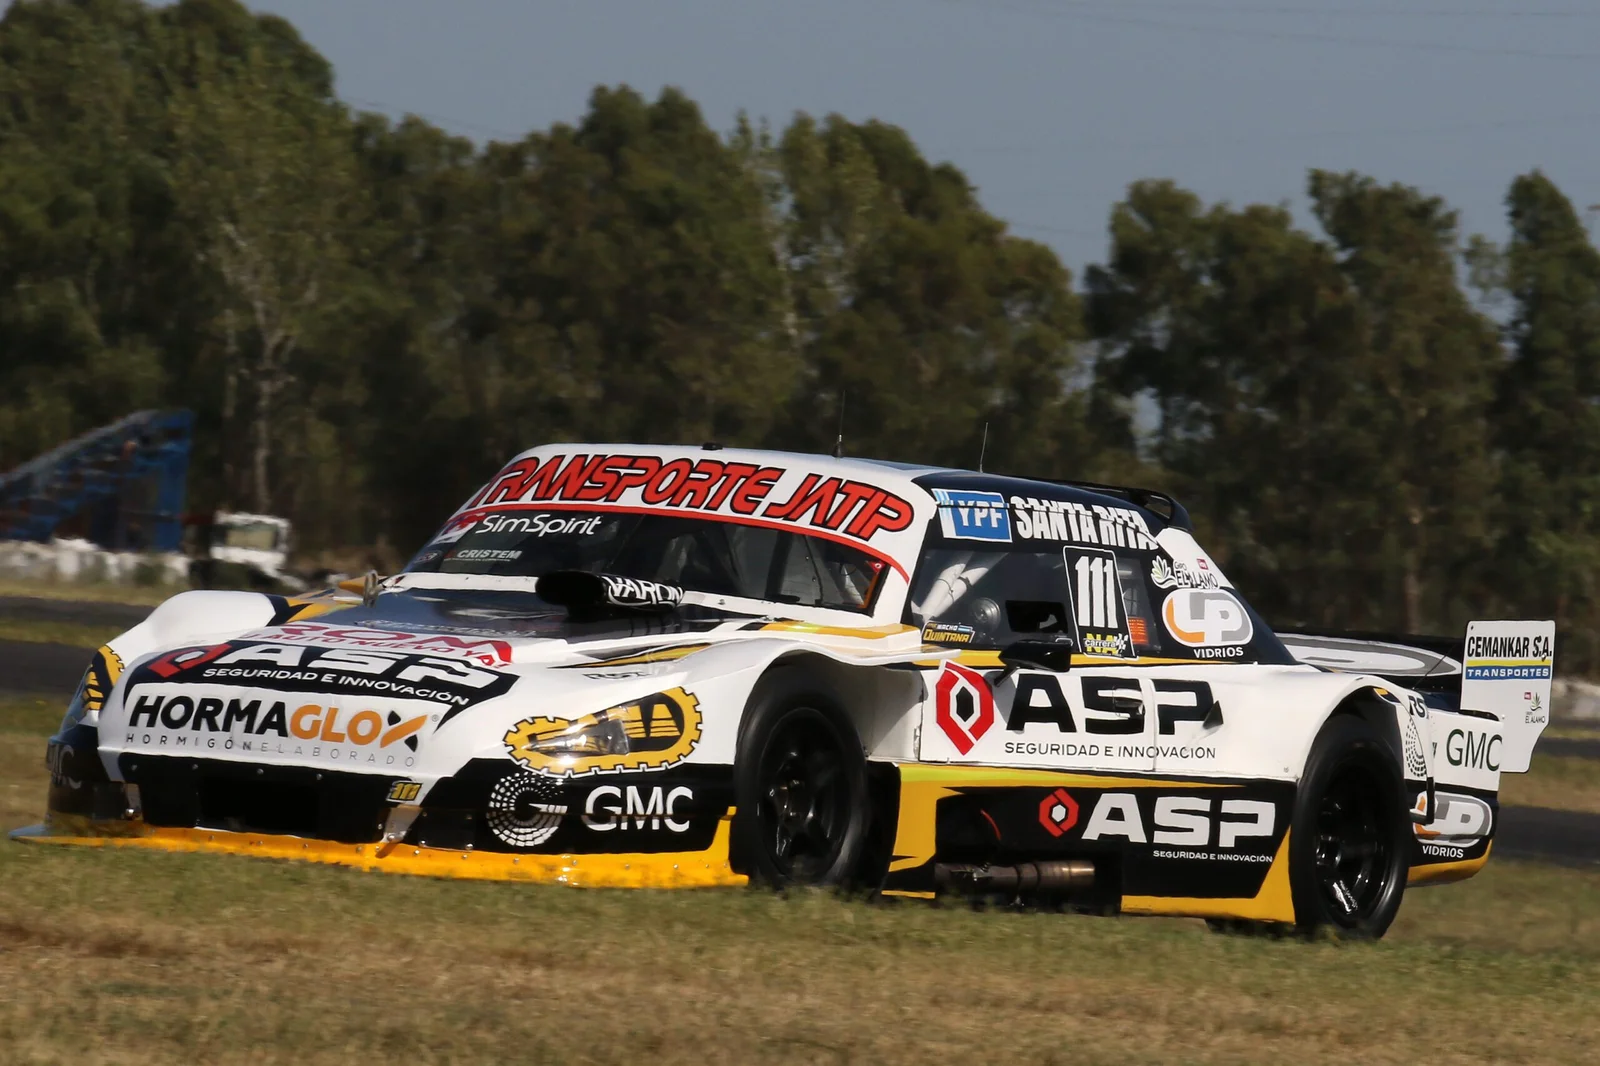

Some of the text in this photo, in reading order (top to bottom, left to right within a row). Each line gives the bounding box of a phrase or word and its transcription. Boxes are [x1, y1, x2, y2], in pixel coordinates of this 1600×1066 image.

[763, 473, 914, 542] JATIP
[958, 499, 1004, 528] YPF
[1010, 495, 1099, 544] SANTA
[475, 514, 602, 537] SimSpirit
[456, 549, 522, 560] CRISTEM
[1074, 555, 1119, 629] 111
[261, 634, 347, 644] AUTO
[348, 641, 455, 653] NUEVO
[1193, 647, 1244, 659] VIDRIOS
[1467, 635, 1552, 658] CEMANKAR S.A.
[212, 644, 501, 689] ASP
[1467, 668, 1549, 677] TRANSPORTES
[203, 667, 470, 706] SEGURIDAD E INNOVACIÓN
[1006, 673, 1214, 735] ASP
[128, 694, 428, 753] HORMAGLOX
[1004, 742, 1100, 757] SEGURIDAD
[1104, 745, 1114, 757] E
[1446, 729, 1502, 771] GMC
[580, 784, 694, 833] GMC
[1081, 792, 1276, 848] ASP
[1153, 850, 1208, 860] SEGURIDAD
[1217, 853, 1273, 863] INNOVACIÓN
[1422, 845, 1464, 859] VIDRIOS
